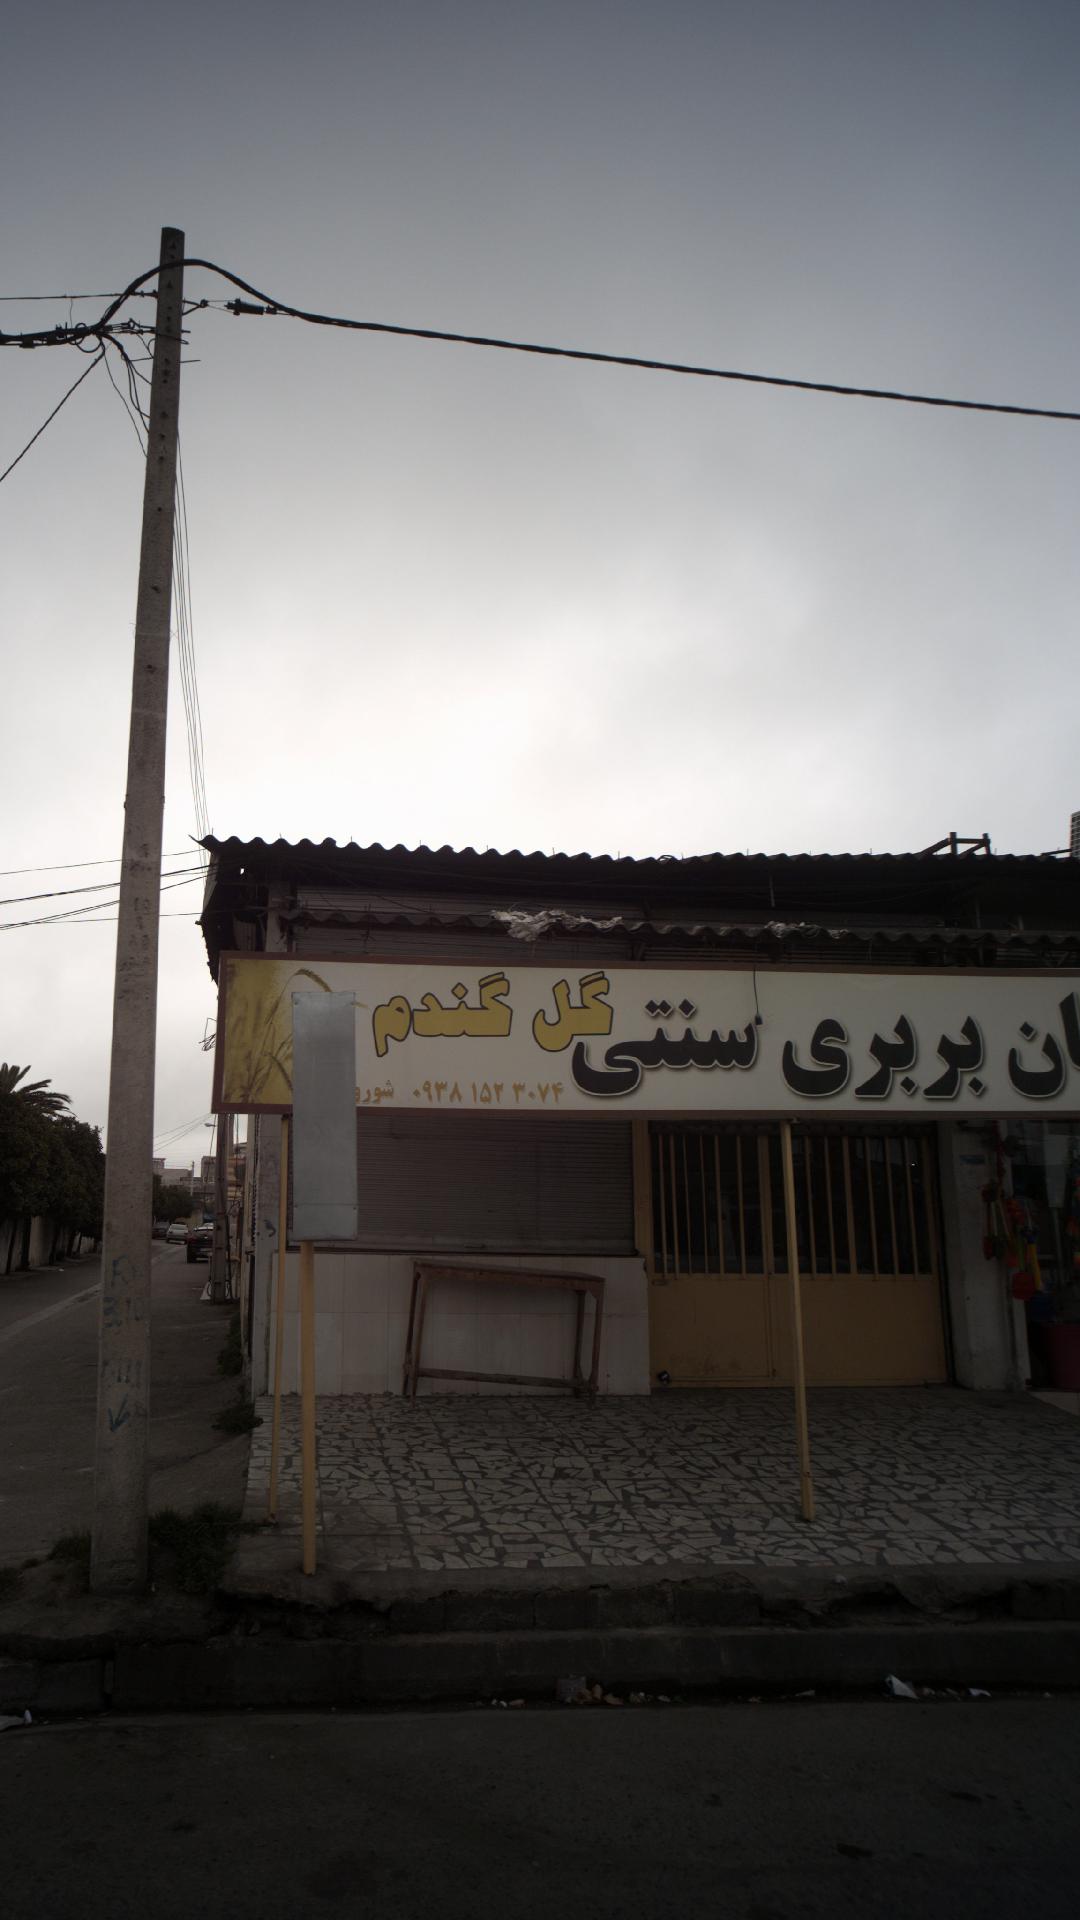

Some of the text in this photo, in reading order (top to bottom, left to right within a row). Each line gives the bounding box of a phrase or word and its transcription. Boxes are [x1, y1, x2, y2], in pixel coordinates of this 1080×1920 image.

[372, 971, 614, 1057] گل گندم
[571, 990, 1080, 1100] ان بربری سنتی
[413, 1080, 462, 1104] ۰۹۳۸
[512, 1081, 564, 1104] ۳۰۷۴
